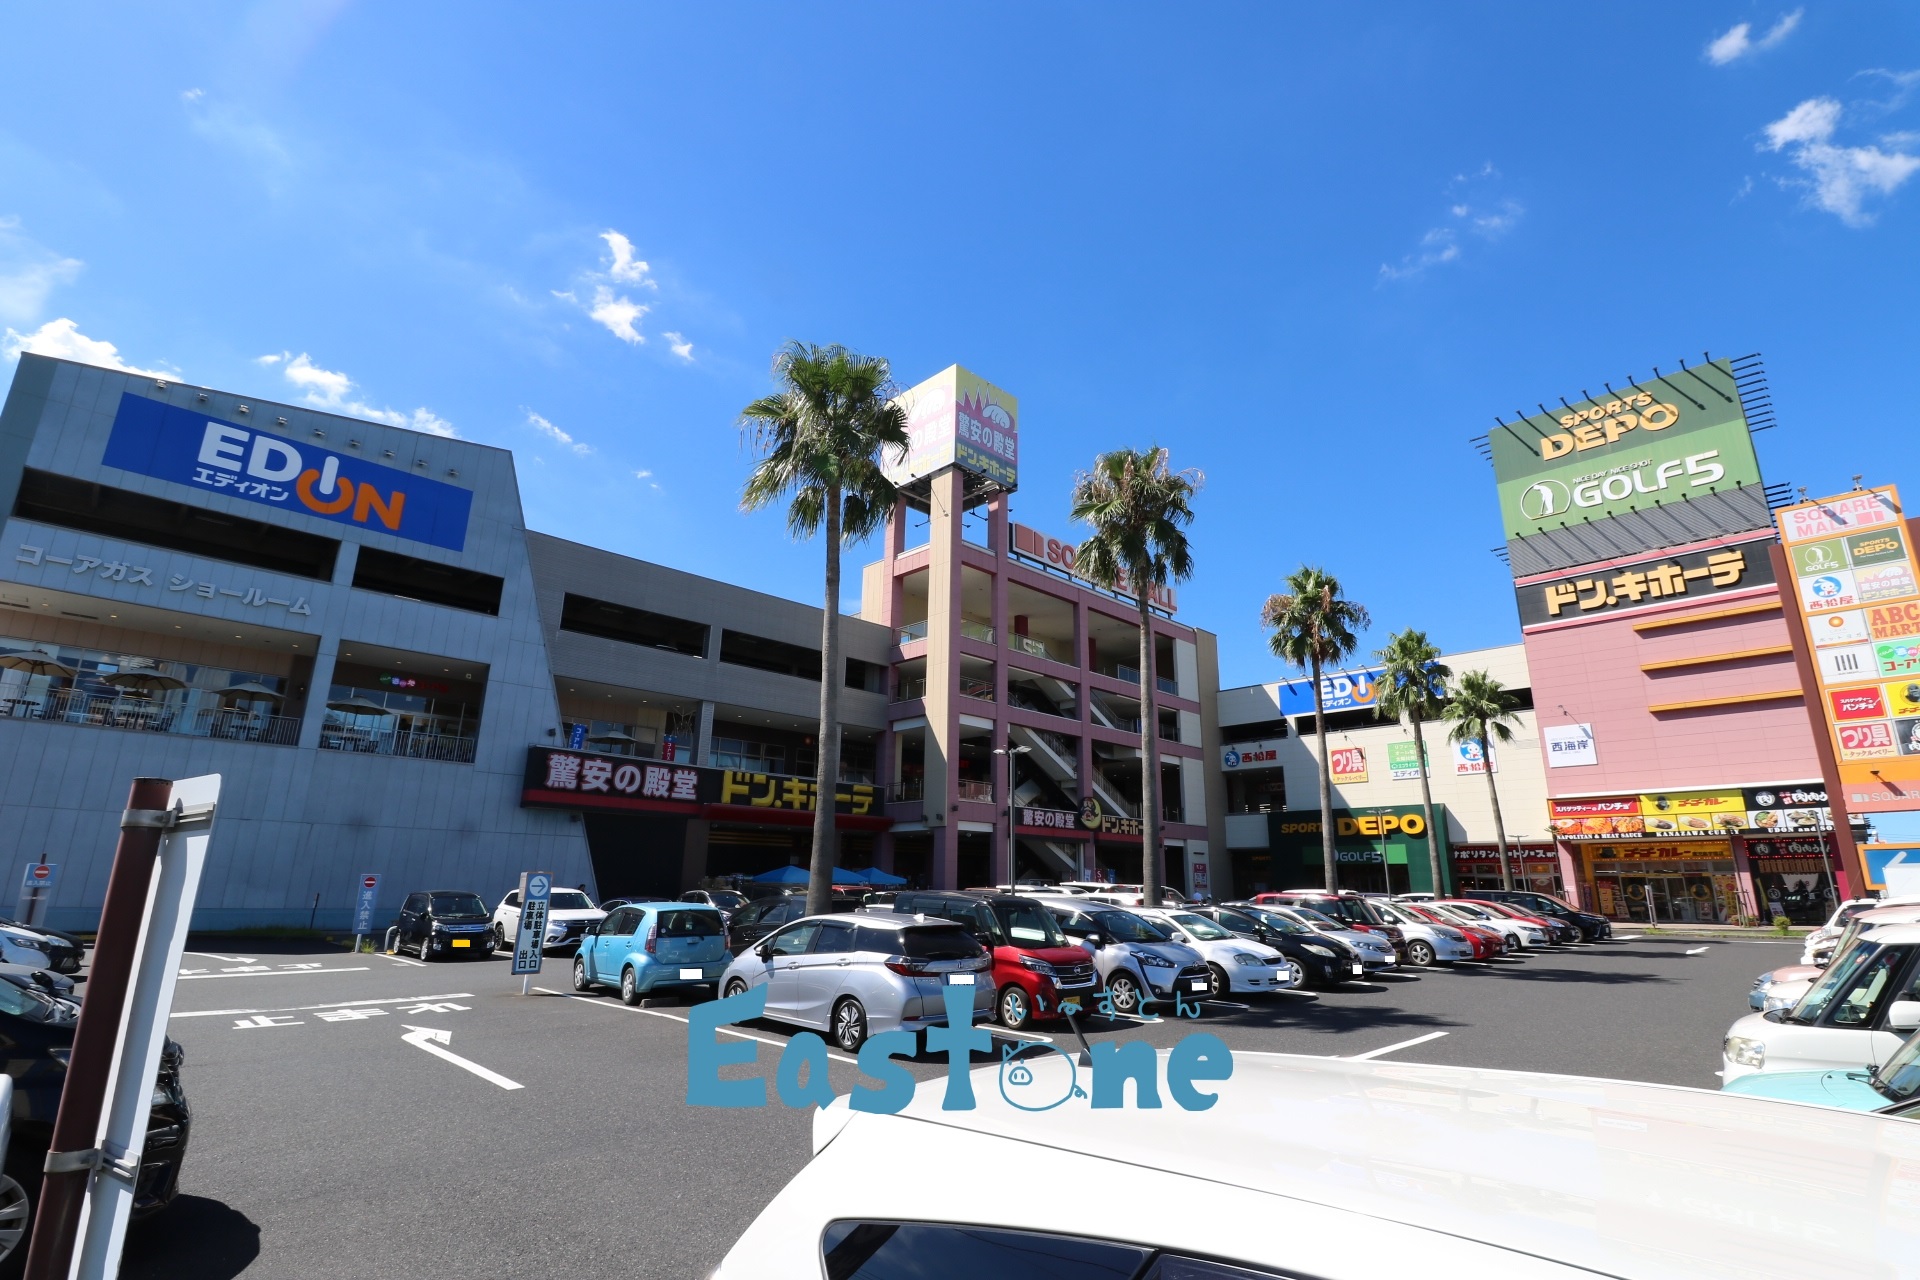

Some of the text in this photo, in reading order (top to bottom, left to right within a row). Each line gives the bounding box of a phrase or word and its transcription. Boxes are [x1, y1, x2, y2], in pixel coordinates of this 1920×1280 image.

[1559, 391, 1652, 429] SPORTS
[958, 411, 1015, 461] 驚安の殿堂
[1540, 403, 1680, 461] DEPO
[1573, 458, 1653, 484] NICE DAY NICE SHOT
[193, 467, 289, 501] エディオン
[1793, 496, 1882, 524] SQUARE
[1796, 518, 1856, 538] MALL
[1853, 541, 1899, 557] DEPO
[1859, 537, 1891, 547] SPORTS
[15, 543, 312, 616] コーアガス ショールーム
[1809, 595, 1855, 610] 西松屋
[1871, 604, 1920, 627] ABC
[1873, 622, 1920, 639] MART
[1883, 658, 1920, 671] コーア
[1550, 739, 1589, 752] 西海岸
[1841, 724, 1890, 747] つり具
[1241, 750, 1277, 763] 西松屋
[1332, 749, 1364, 773] つり具
[546, 752, 698, 800] 驚安の殿堂
[1393, 770, 1420, 778] エディオ
[1023, 809, 1075, 829] 驚安の殿堂
[1281, 822, 1323, 833] SPORT
[1337, 814, 1425, 836] DEPO
[1624, 846, 1692, 857] ゴーゴーカレー
[357, 890, 373, 930] 進入禁止
[518, 901, 536, 969] 駐車場 出口
[528, 901, 545, 969] 立体駐車場入口
